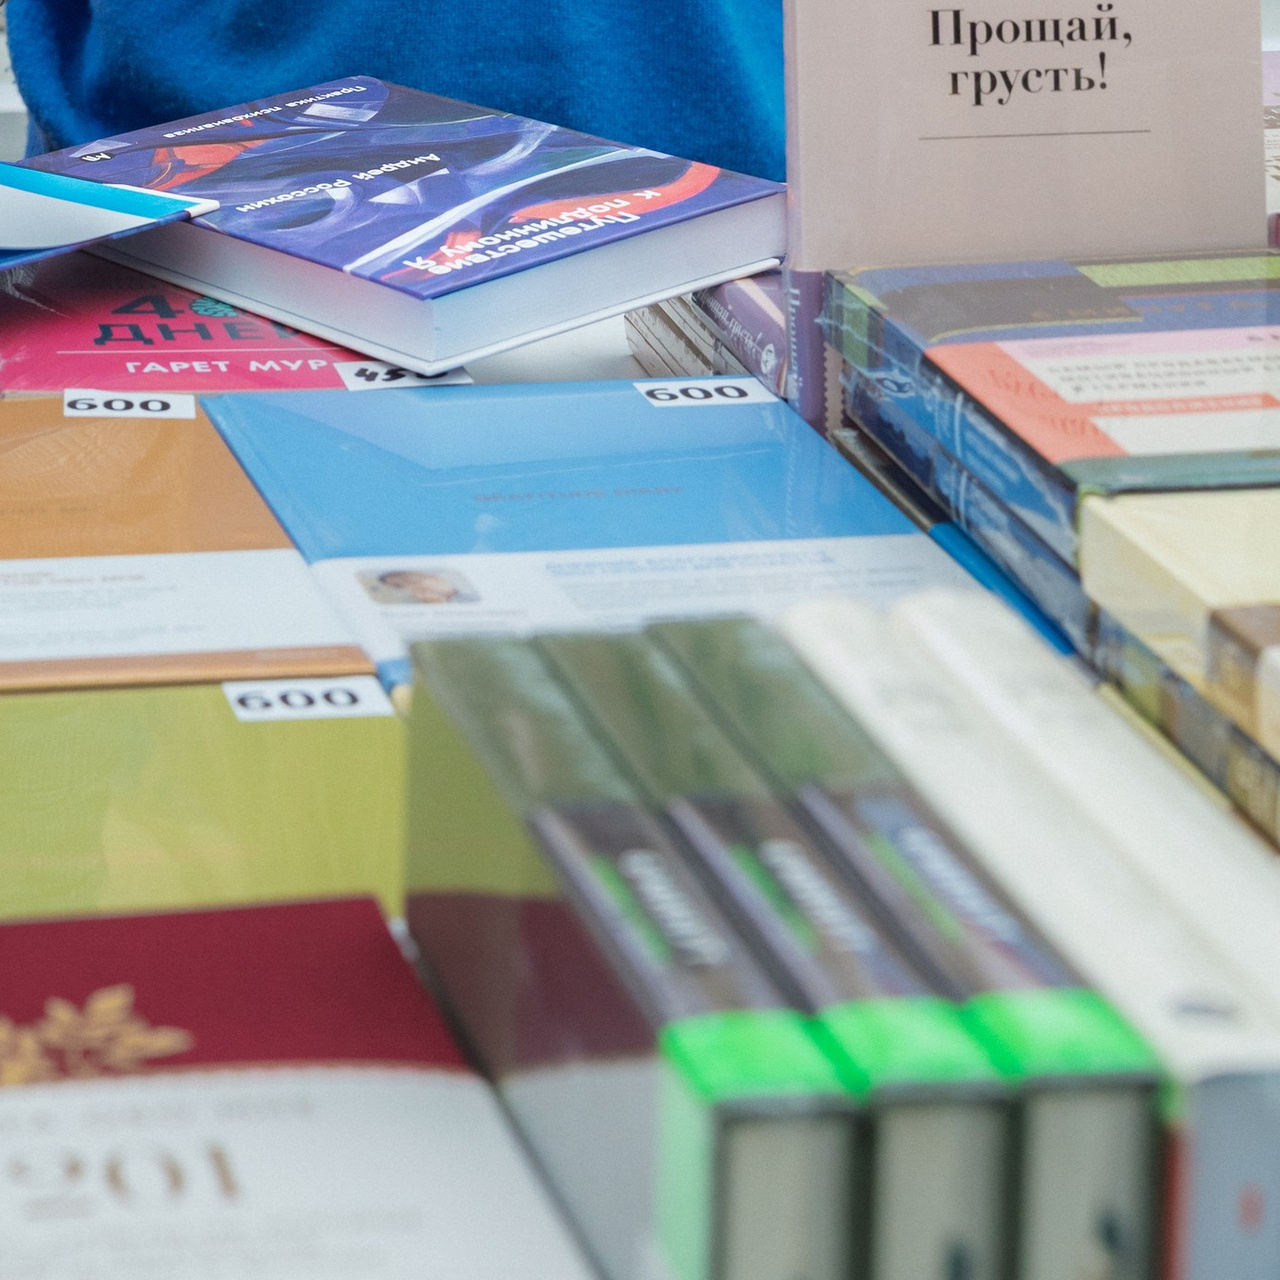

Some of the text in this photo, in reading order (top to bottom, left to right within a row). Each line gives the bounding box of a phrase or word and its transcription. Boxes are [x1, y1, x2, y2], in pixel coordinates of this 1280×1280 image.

[927, 3, 1133, 56] Прощай,
[949, 51, 1109, 107] грусть!
[163, 84, 367, 140] Практика психоанализа
[235, 151, 441, 214] Андрей Россохин
[426, 210, 641, 276] Путешествие
[439, 198, 631, 257] подлинному
[125, 358, 329, 375] ГАРЕТ МУР
[644, 384, 750, 403] 600
[66, 397, 172, 414] 600
[236, 688, 360, 712] 600
